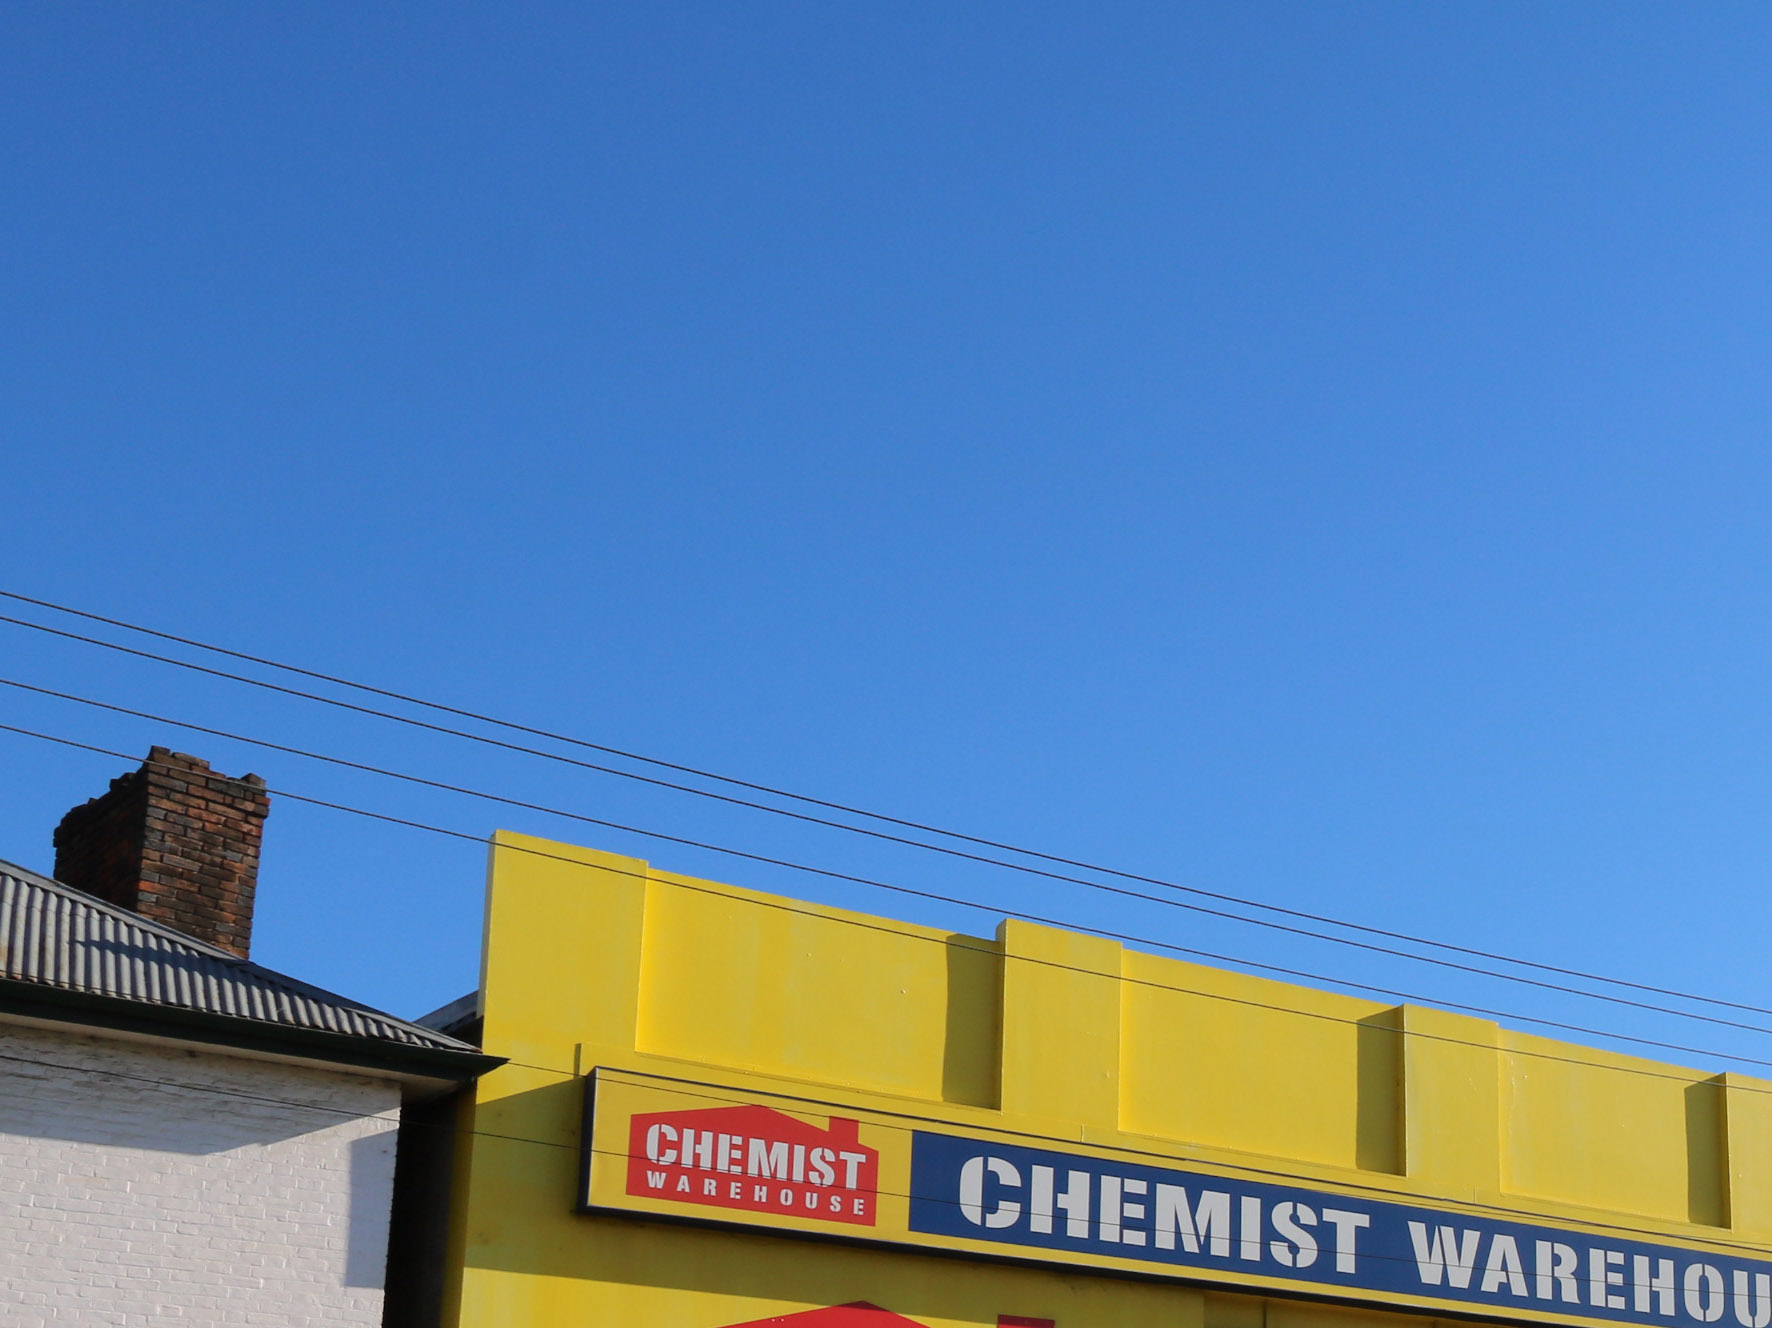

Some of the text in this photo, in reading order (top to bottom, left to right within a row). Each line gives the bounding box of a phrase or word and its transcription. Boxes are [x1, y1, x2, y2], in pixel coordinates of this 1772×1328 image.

[645, 1123, 867, 1190] CHEMIST
[646, 1170, 865, 1216] WAREHOUSE
[958, 1155, 1371, 1275] CHEMIST
